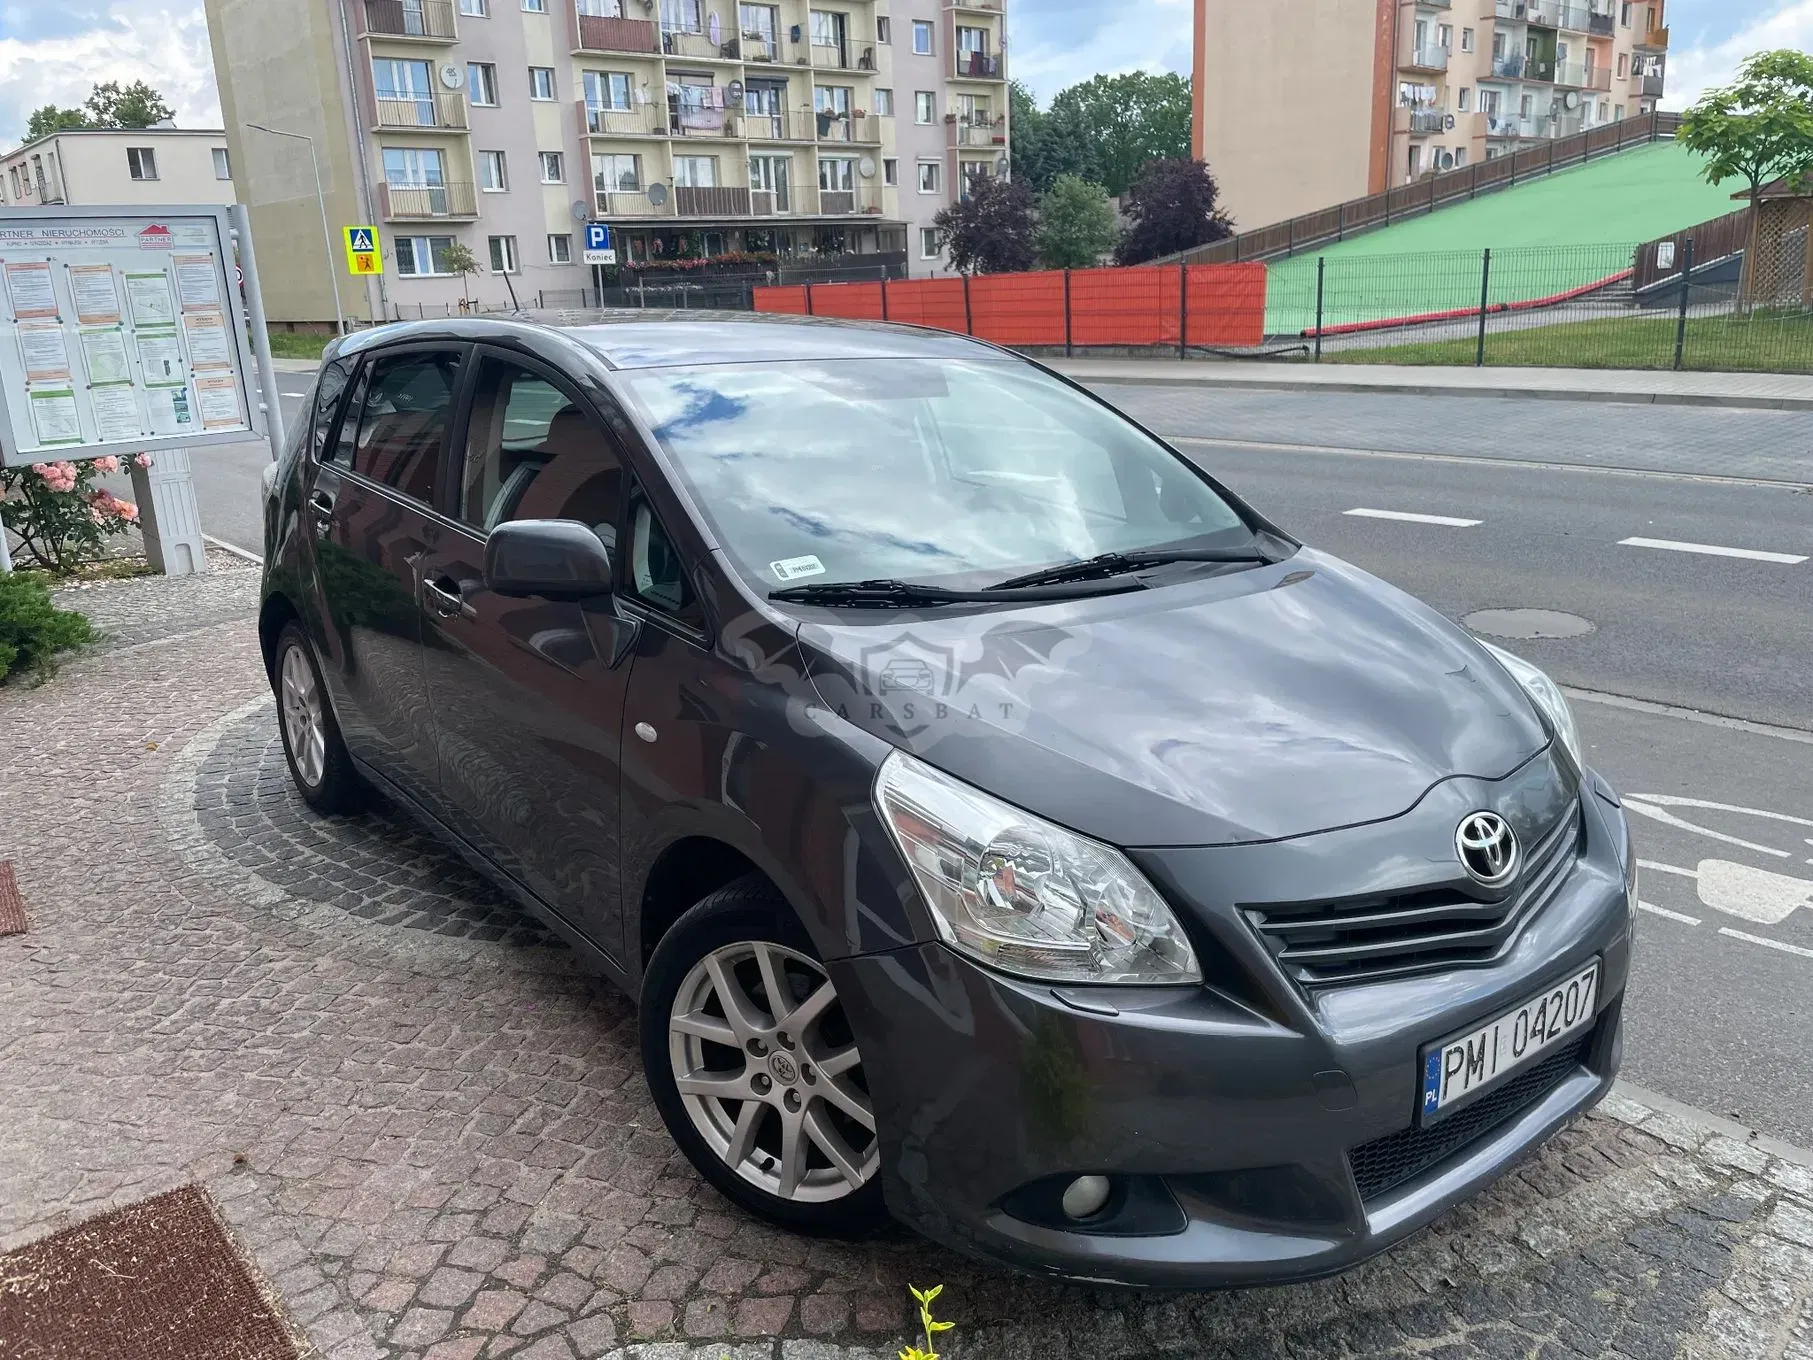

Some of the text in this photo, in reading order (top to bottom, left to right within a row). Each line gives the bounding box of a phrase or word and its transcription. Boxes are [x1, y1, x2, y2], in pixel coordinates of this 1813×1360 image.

[41, 228, 125, 238] NIERUCHOMOŚCI
[591, 227, 604, 247] P
[1442, 969, 1595, 1100] PMI 04207
[1425, 1089, 1438, 1106] PL
